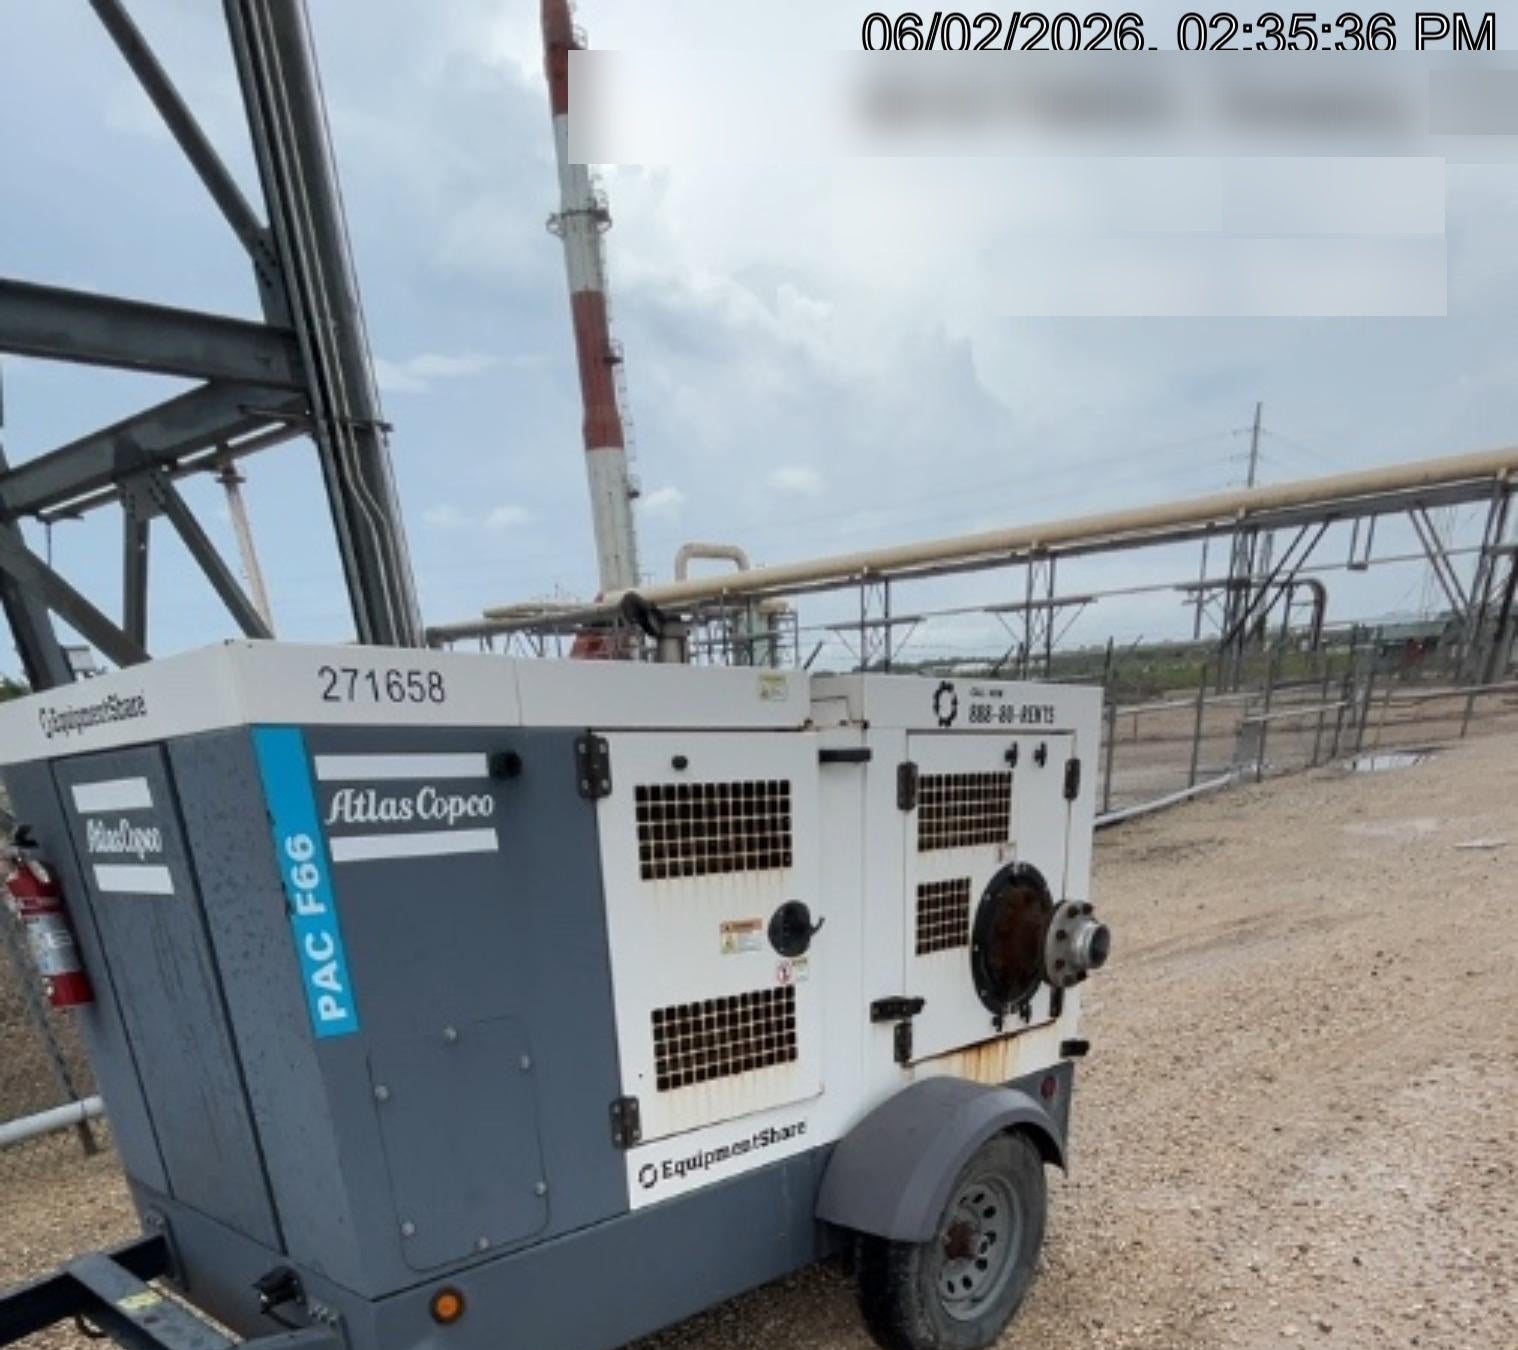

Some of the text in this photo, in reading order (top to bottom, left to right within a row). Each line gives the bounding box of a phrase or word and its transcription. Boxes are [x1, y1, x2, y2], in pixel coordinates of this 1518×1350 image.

[318, 665, 445, 703] 271658
[285, 833, 348, 1021] PAC F66
[661, 1120, 807, 1180] EquipmentShare
